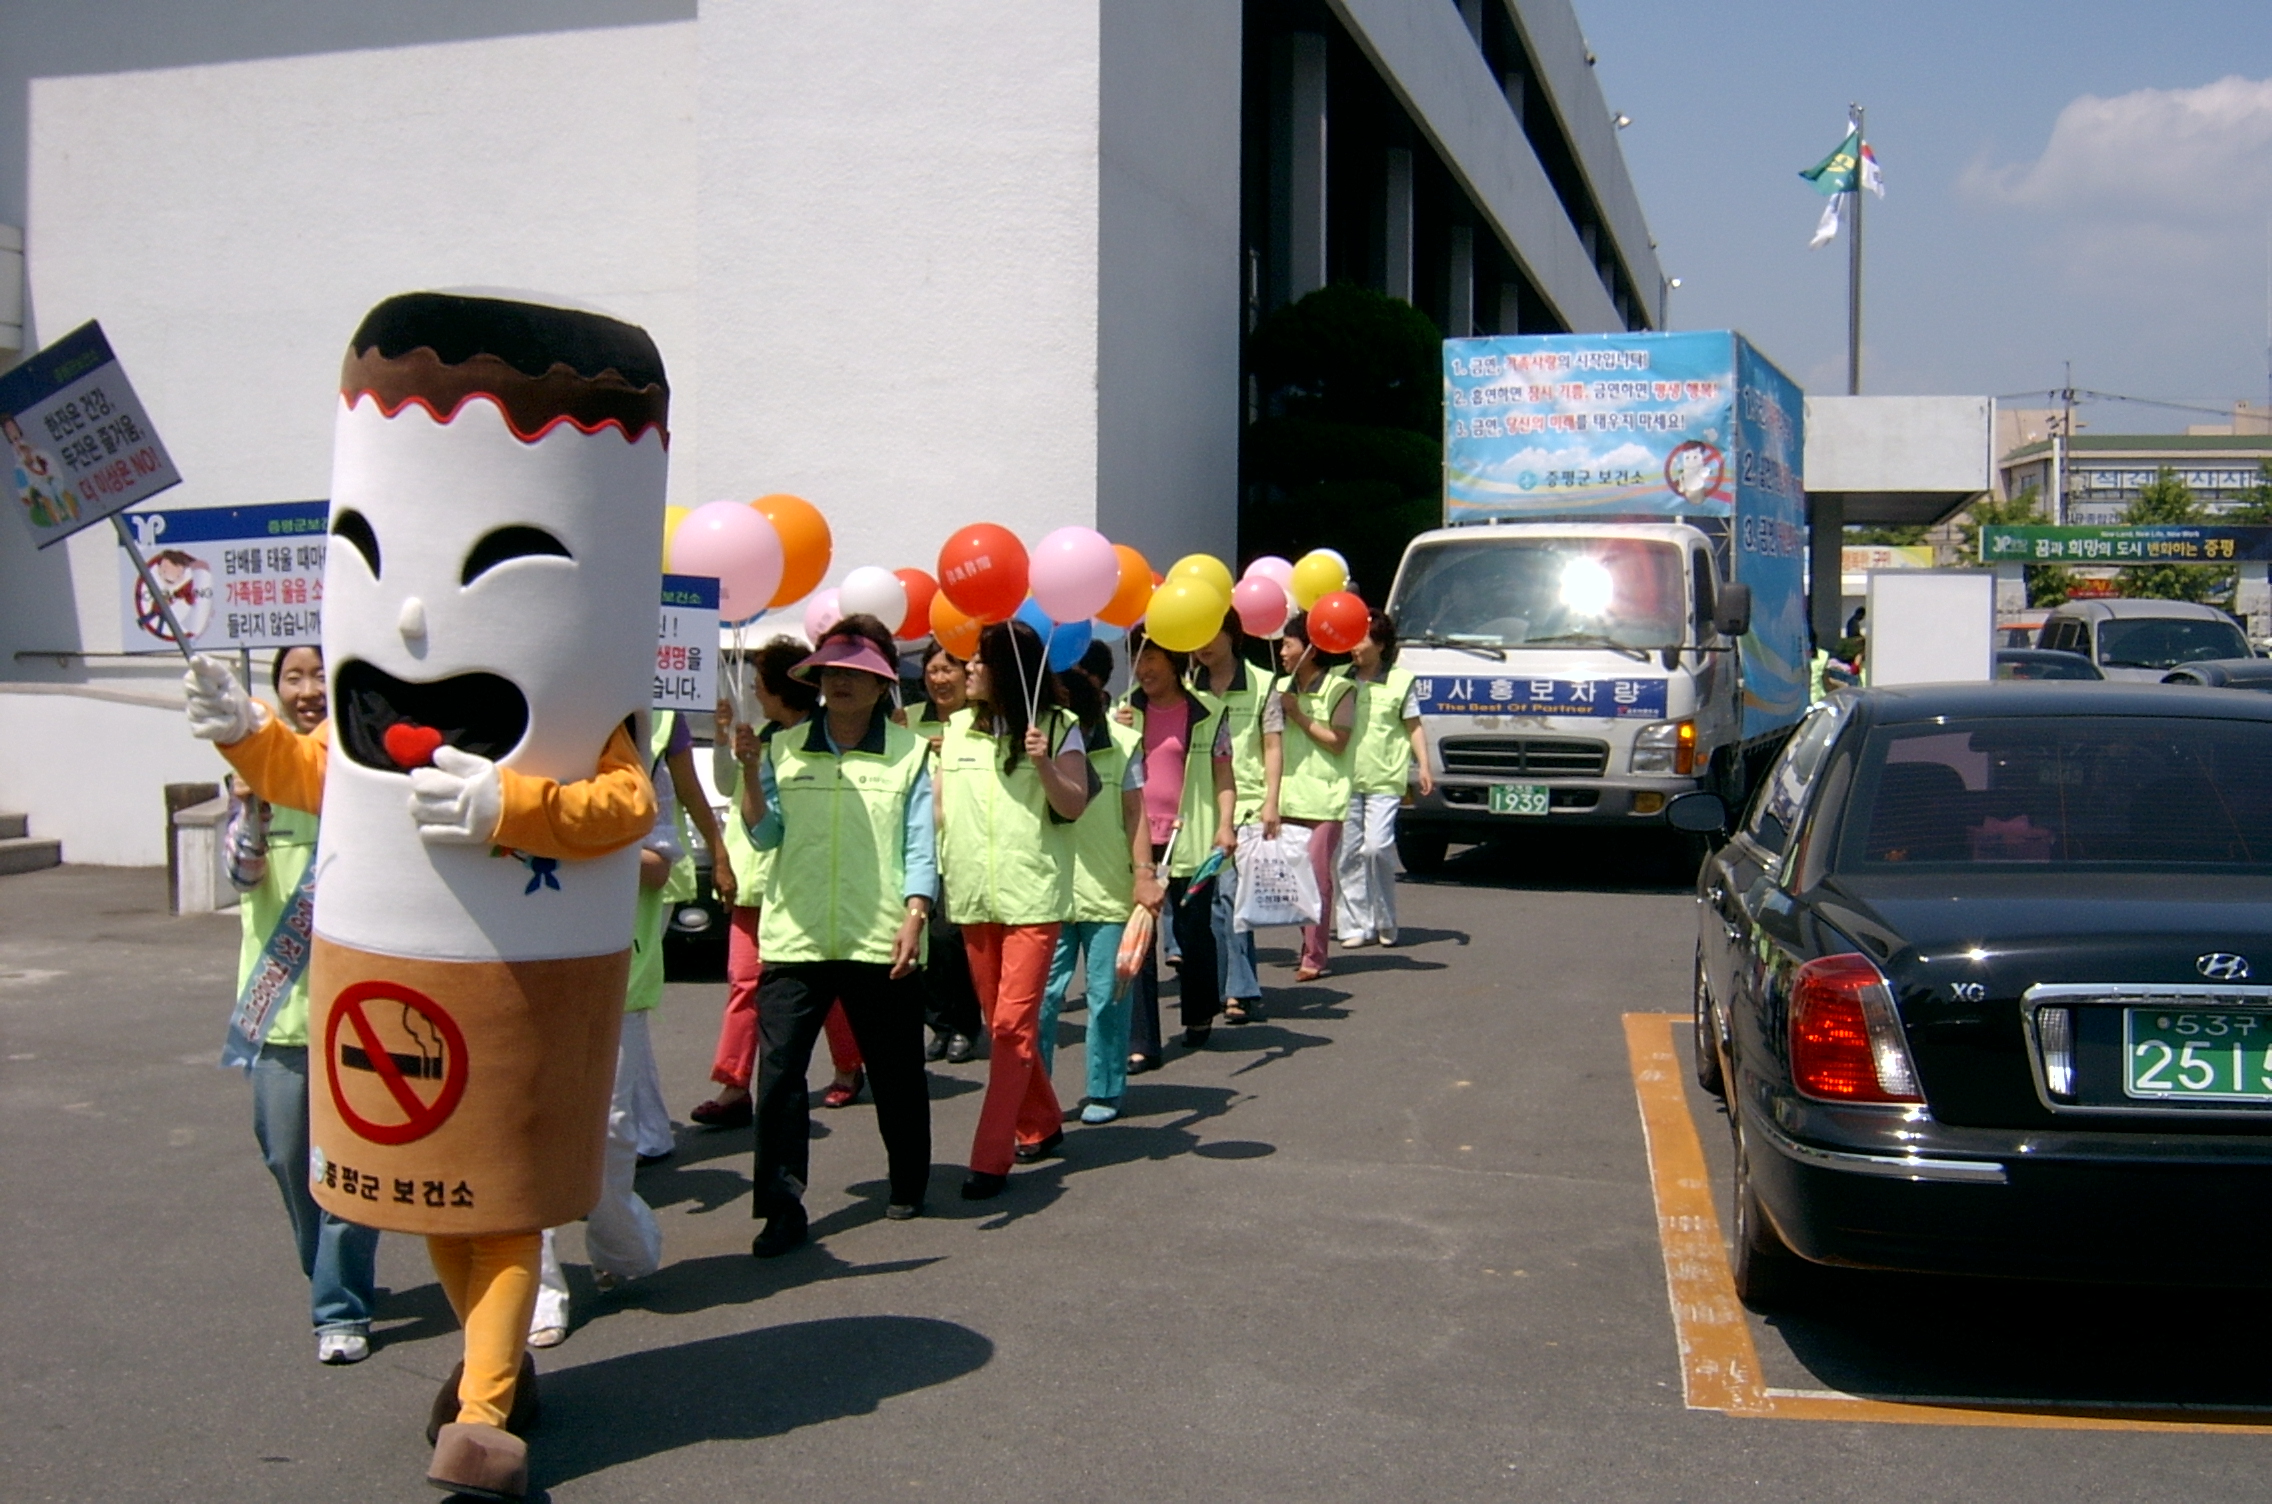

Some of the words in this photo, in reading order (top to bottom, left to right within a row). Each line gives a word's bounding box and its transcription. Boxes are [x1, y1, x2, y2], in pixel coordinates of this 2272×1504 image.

[1599, 470, 1645, 487] 보건소
[2117, 541, 2142, 556] 도시
[1494, 793, 1546, 812] 1939
[1950, 982, 1986, 1002] XG
[2176, 1014, 2258, 1036] 53구
[393, 1177, 474, 1208] 보건소
